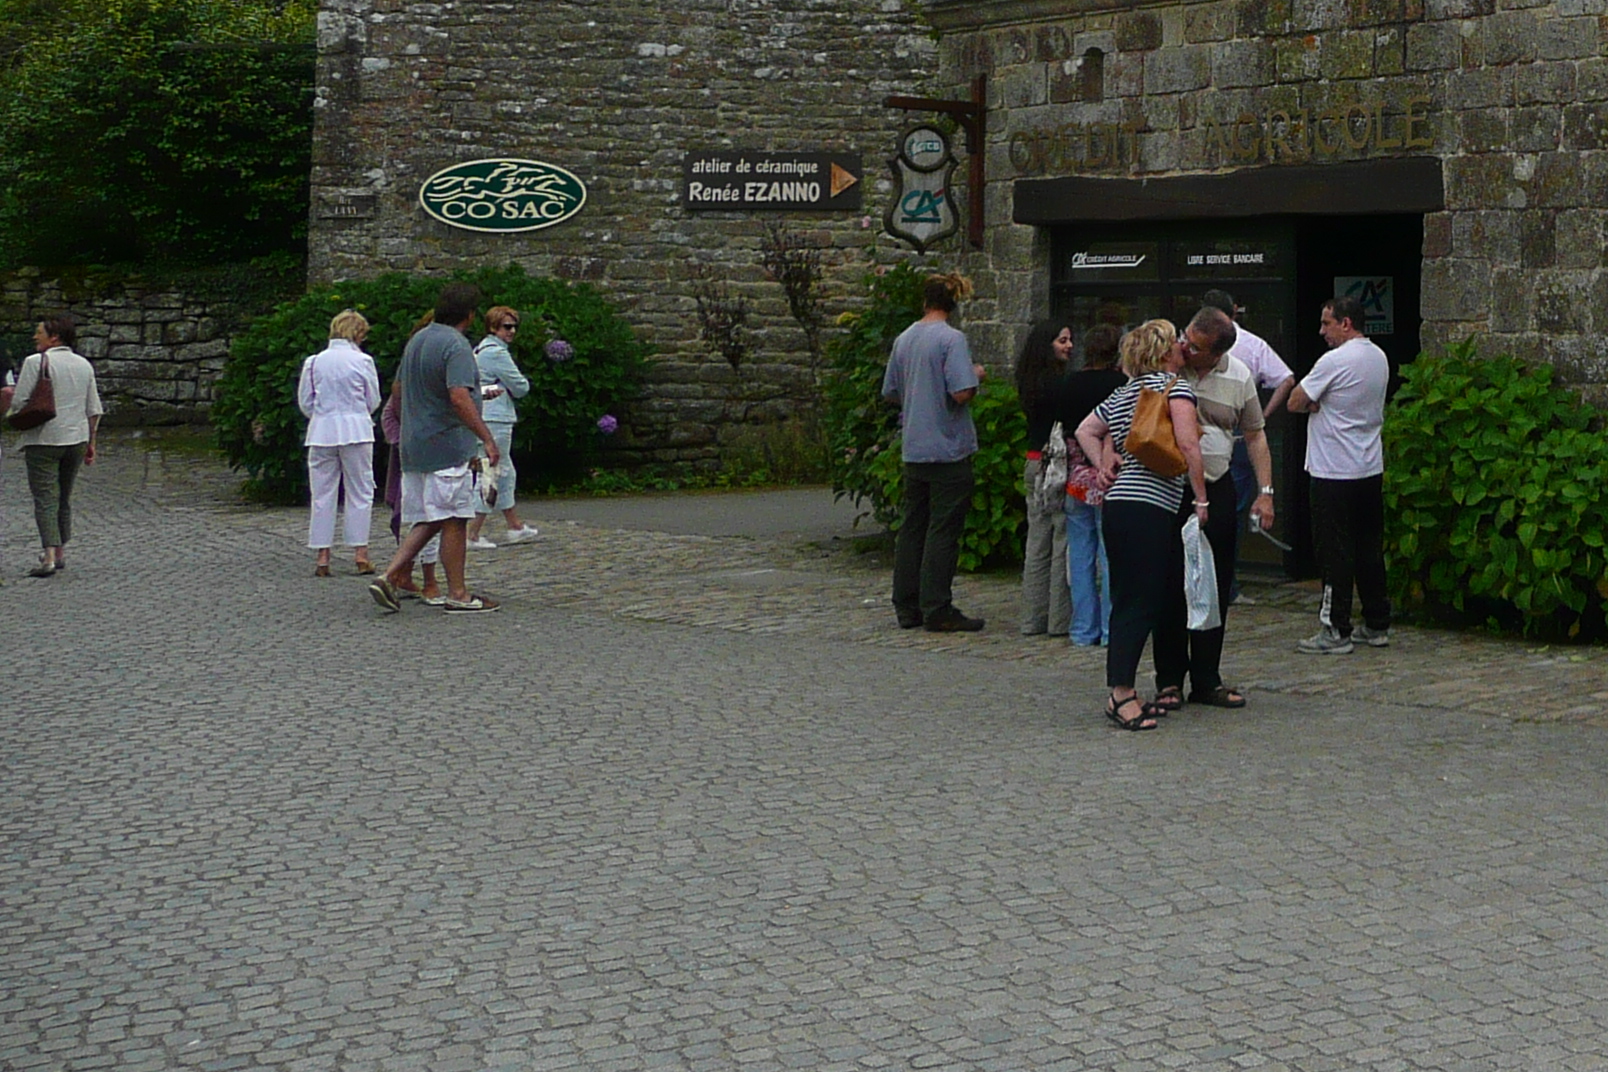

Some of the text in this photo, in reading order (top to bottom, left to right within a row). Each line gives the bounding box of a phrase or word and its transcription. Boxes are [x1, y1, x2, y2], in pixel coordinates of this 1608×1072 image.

[1203, 94, 1435, 160] AGRICOLE
[692, 157, 819, 177] atelier de céramique
[689, 181, 821, 202] Renée EZANNO
[1206, 254, 1231, 265] SERVICE
[1233, 253, 1264, 264] BANCAIRE
